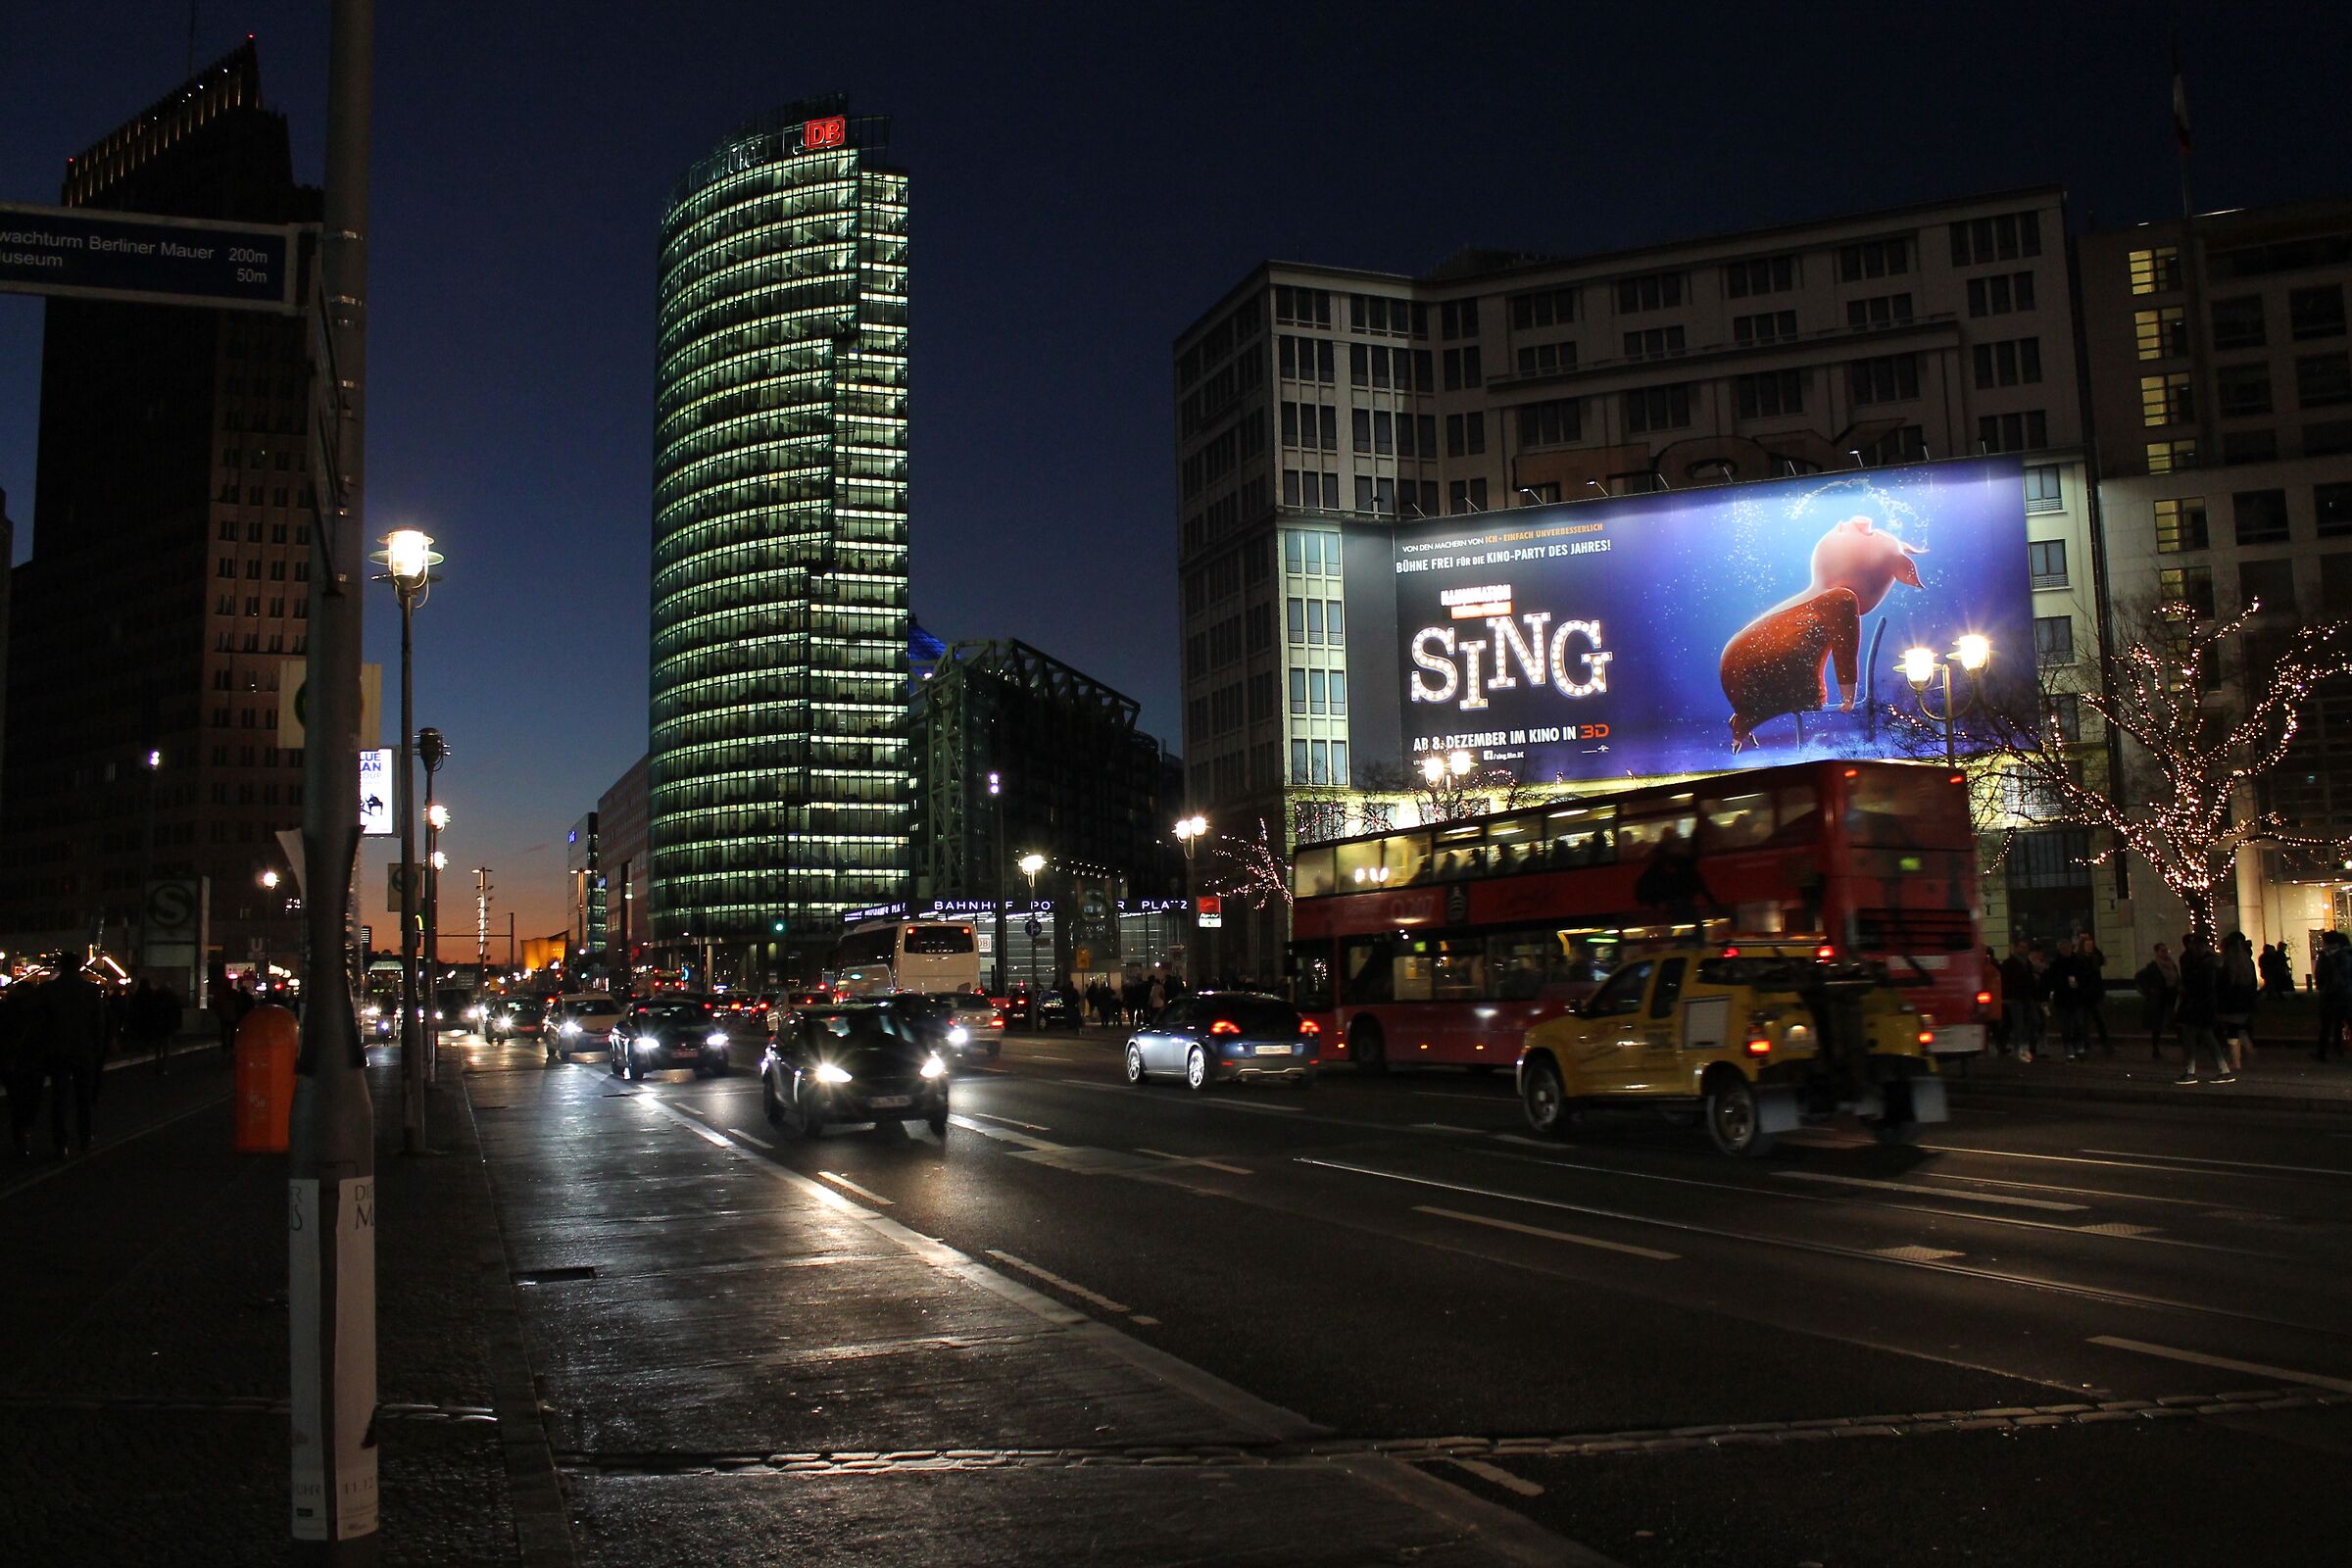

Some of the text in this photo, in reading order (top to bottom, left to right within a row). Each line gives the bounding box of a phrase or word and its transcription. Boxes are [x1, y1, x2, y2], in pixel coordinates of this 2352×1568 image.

[809, 122, 841, 145] DB
[0, 251, 64, 268] useum
[89, 235, 156, 255] Berliner
[161, 242, 215, 260] Mauer
[228, 247, 268, 264] 200m
[237, 268, 268, 283] 50m
[1419, 543, 1434, 552] DEN
[1434, 540, 1467, 550] MACHERN
[1467, 537, 1485, 546] VON
[1485, 534, 1497, 544] ICH
[1503, 530, 1535, 542] EINFACH
[1396, 539, 1611, 573] BÜHNE FREI FÜR DIE KINO-PARTY DES JAHRES!
[1410, 612, 1614, 711] SING
[1412, 737, 1429, 752] AB
[1446, 731, 1507, 750] DEZEMBER
[1509, 729, 1527, 745] IM
[1529, 726, 1560, 743] KINO
[1562, 725, 1577, 741] IN
[1580, 723, 1610, 739] 3D
[361, 753, 381, 761] UE
[361, 761, 381, 771] AN
[934, 901, 1013, 910] BAHNHF
